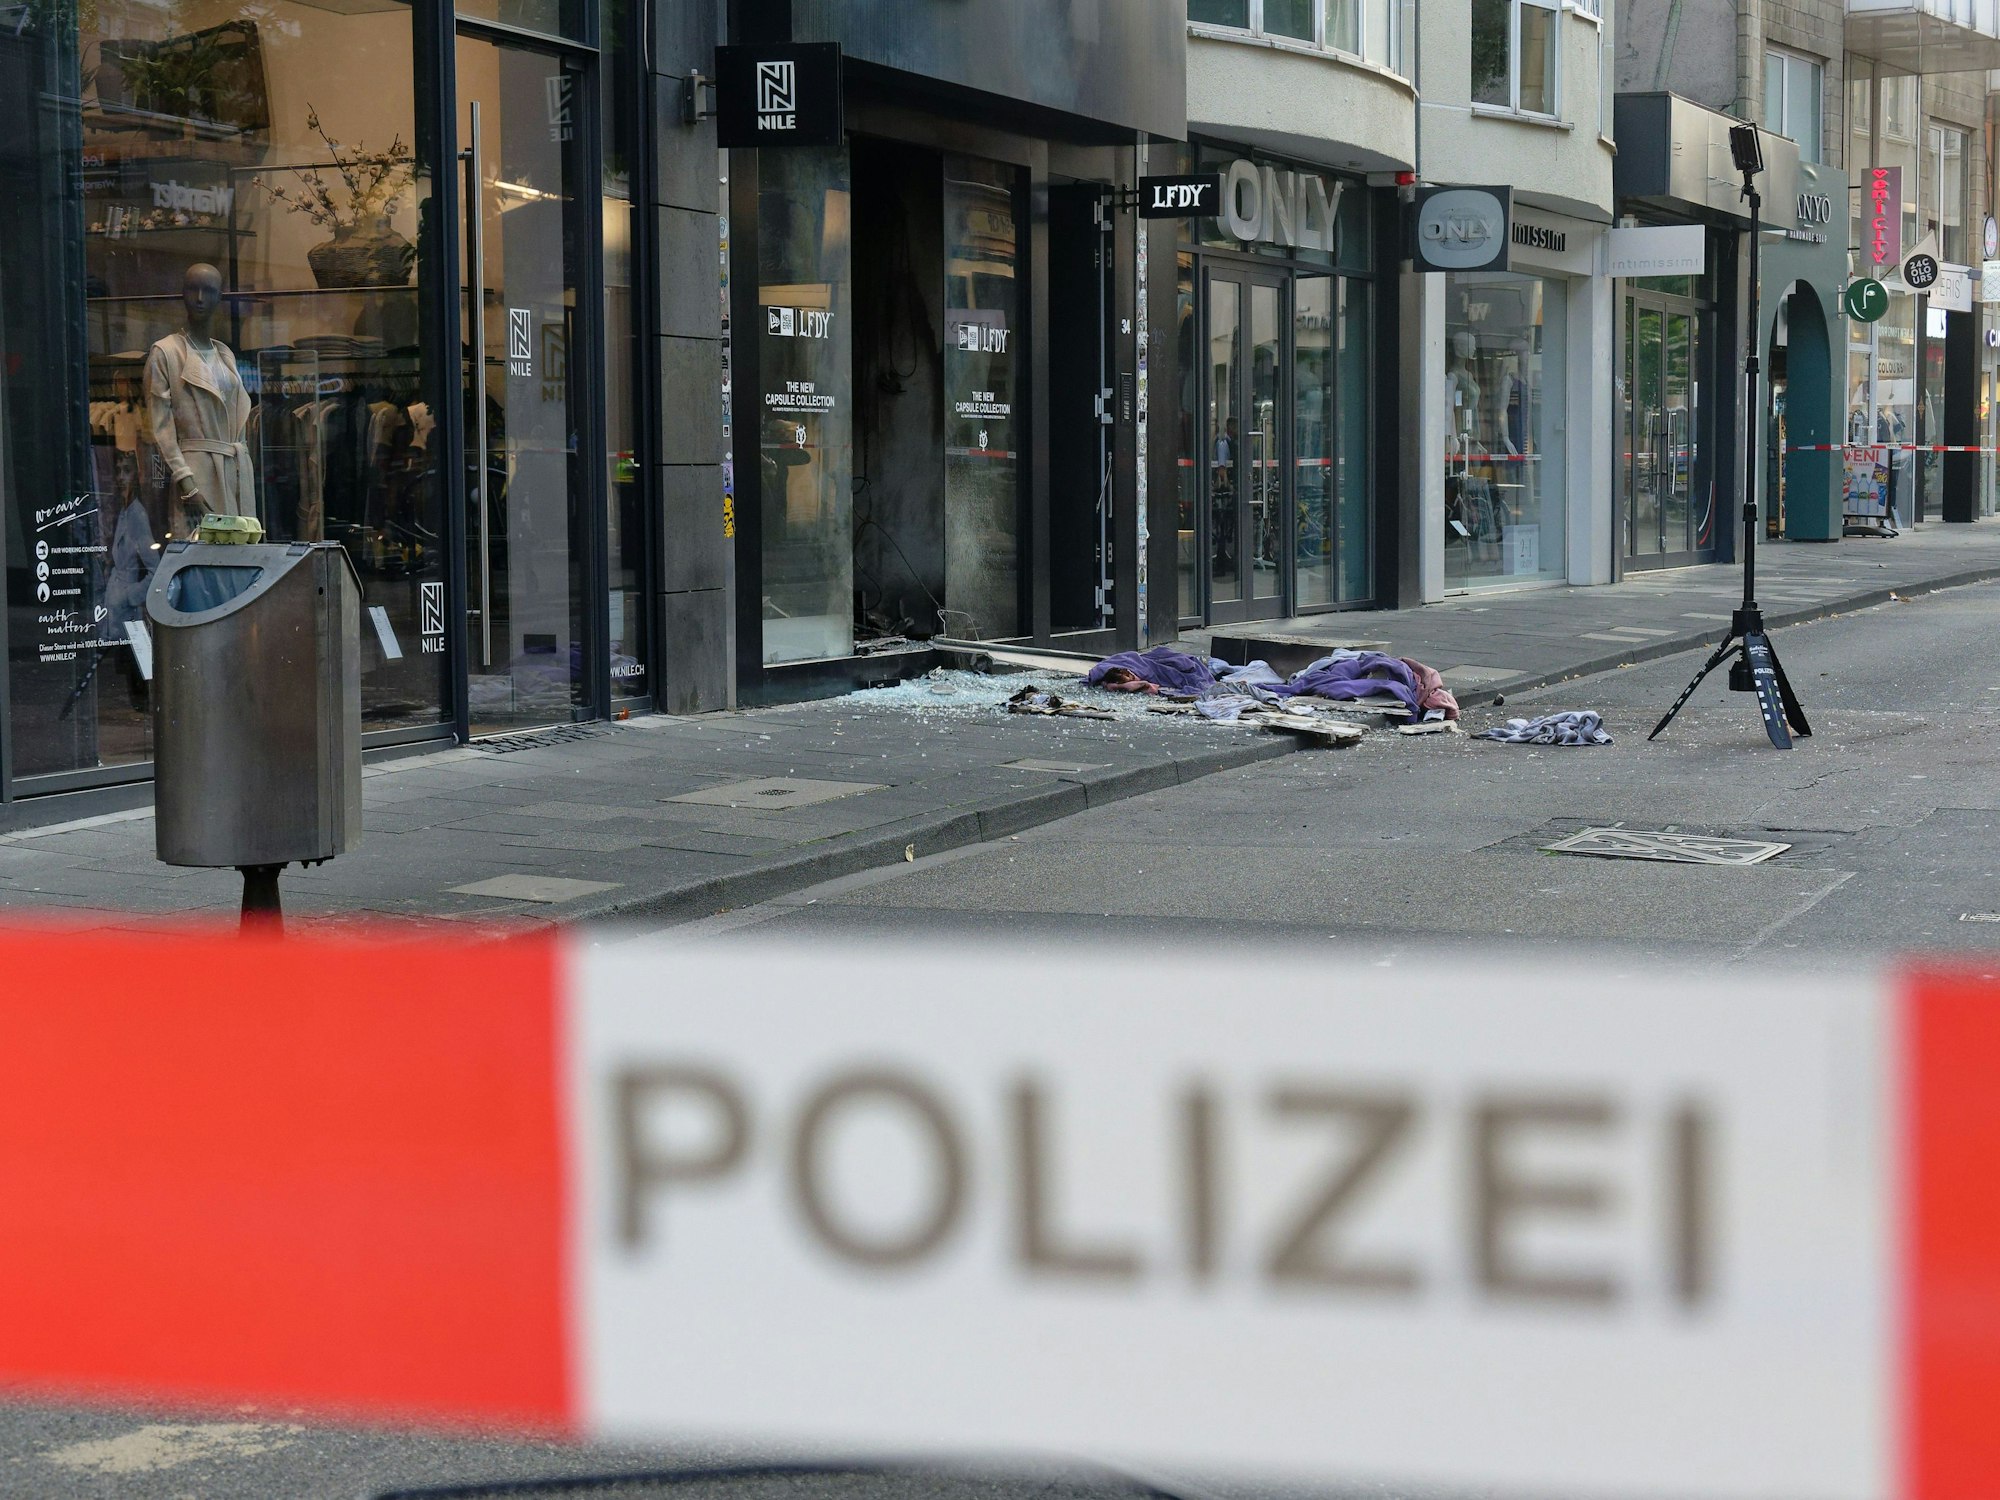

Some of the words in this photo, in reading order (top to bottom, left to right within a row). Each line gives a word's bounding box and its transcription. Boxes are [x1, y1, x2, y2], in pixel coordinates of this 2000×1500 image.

[757, 114, 796, 130] NILE
[1222, 158, 1343, 252] ONLY
[1423, 218, 1492, 241] ONLY
[1612, 258, 1698, 270] intimissimi
[1910, 258, 1930, 270] 24C
[1911, 266, 1931, 277] OLO
[1913, 273, 1933, 285] URS
[1121, 319, 1131, 334] 34
[510, 362, 532, 376] NILE
[1878, 362, 1904, 374] COLOURS
[786, 381, 799, 392] THE
[800, 381, 815, 393] NEW
[765, 393, 795, 405] CAPSULE
[796, 394, 835, 407] COLLECTION
[972, 391, 982, 401] THE
[983, 391, 995, 402] NEW
[955, 402, 979, 413] CAPSULE
[980, 402, 1011, 414] COLLECTION
[1843, 449, 1879, 462] VENI
[55, 494, 90, 514] care
[38, 609, 79, 623] earth
[47, 621, 97, 635] matters
[39, 643, 54, 652] Dieser
[54, 642, 66, 650] Store
[67, 641, 76, 649] wird
[84, 640, 98, 648] 100%
[422, 637, 445, 653] NILE
[40, 652, 76, 662] WWW.NILE.CH
[603, 1055, 1723, 1316] POLIZEI
